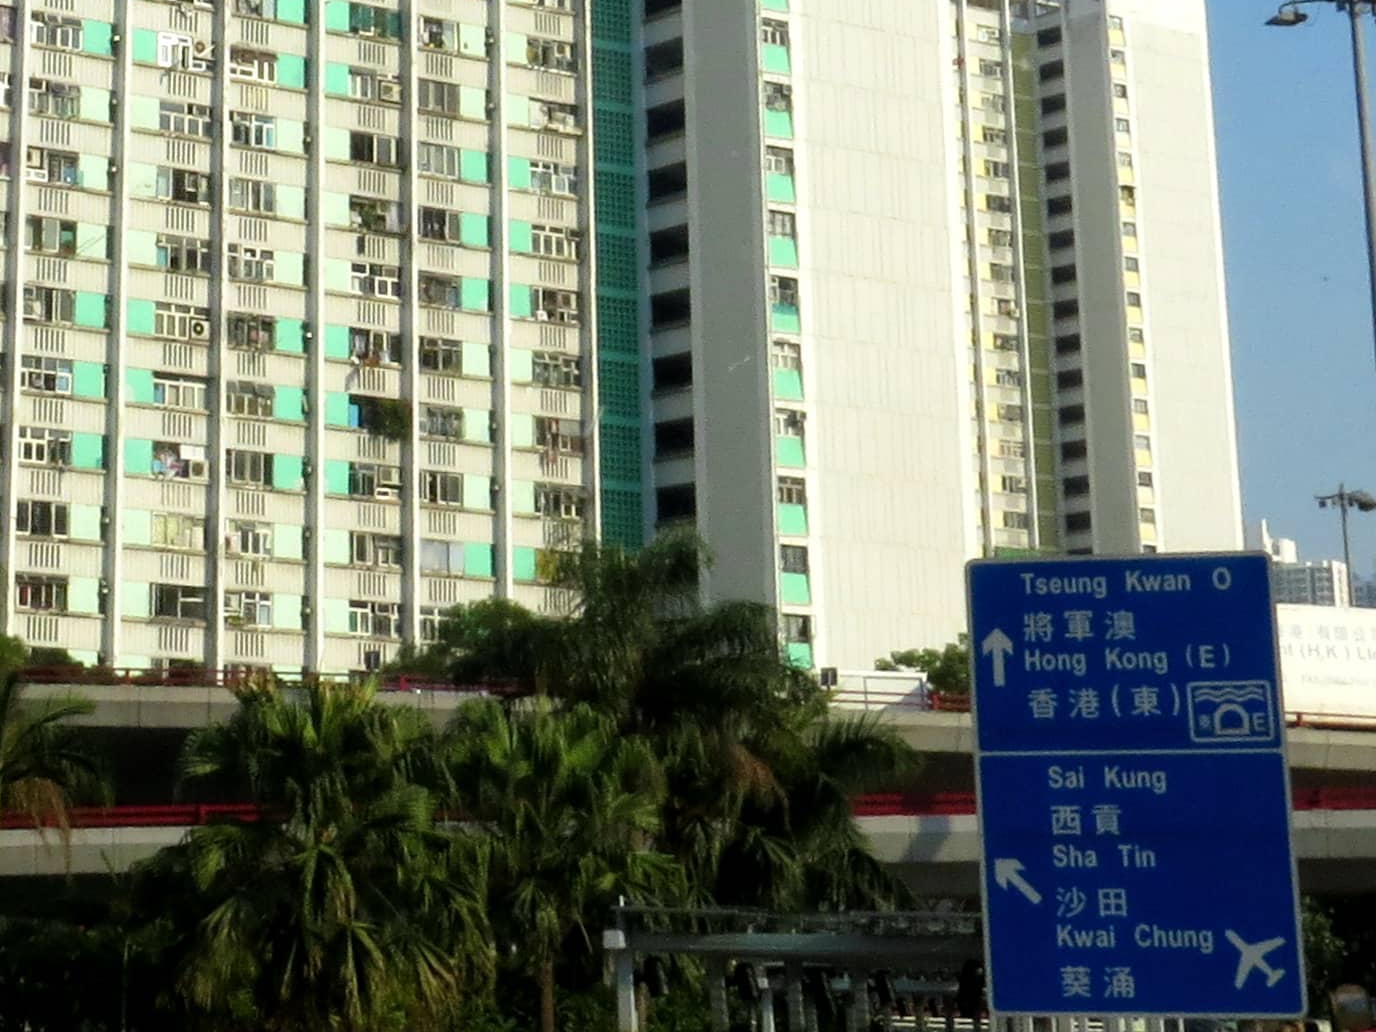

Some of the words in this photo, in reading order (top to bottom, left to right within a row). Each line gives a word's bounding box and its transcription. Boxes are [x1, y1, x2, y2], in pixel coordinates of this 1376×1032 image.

[1020, 572, 1107, 598] Tseung
[1125, 569, 1191, 592] Kwan
[1212, 567, 1231, 589] O
[1022, 610, 1137, 641] 將軍澳
[1024, 649, 1086, 676] Hong
[1105, 646, 1167, 674] Kong
[1185, 643, 1230, 669] (E)
[1253, 713, 1266, 731] E
[1048, 766, 1084, 789] Sai
[1104, 765, 1167, 793] Kung
[1050, 804, 1121, 836] 西貢
[1053, 844, 1097, 868] Sha
[1117, 843, 1156, 868] Tin
[1055, 887, 1128, 918] 沙田
[1056, 924, 1115, 947] Kwai
[1134, 923, 1214, 953] Chung
